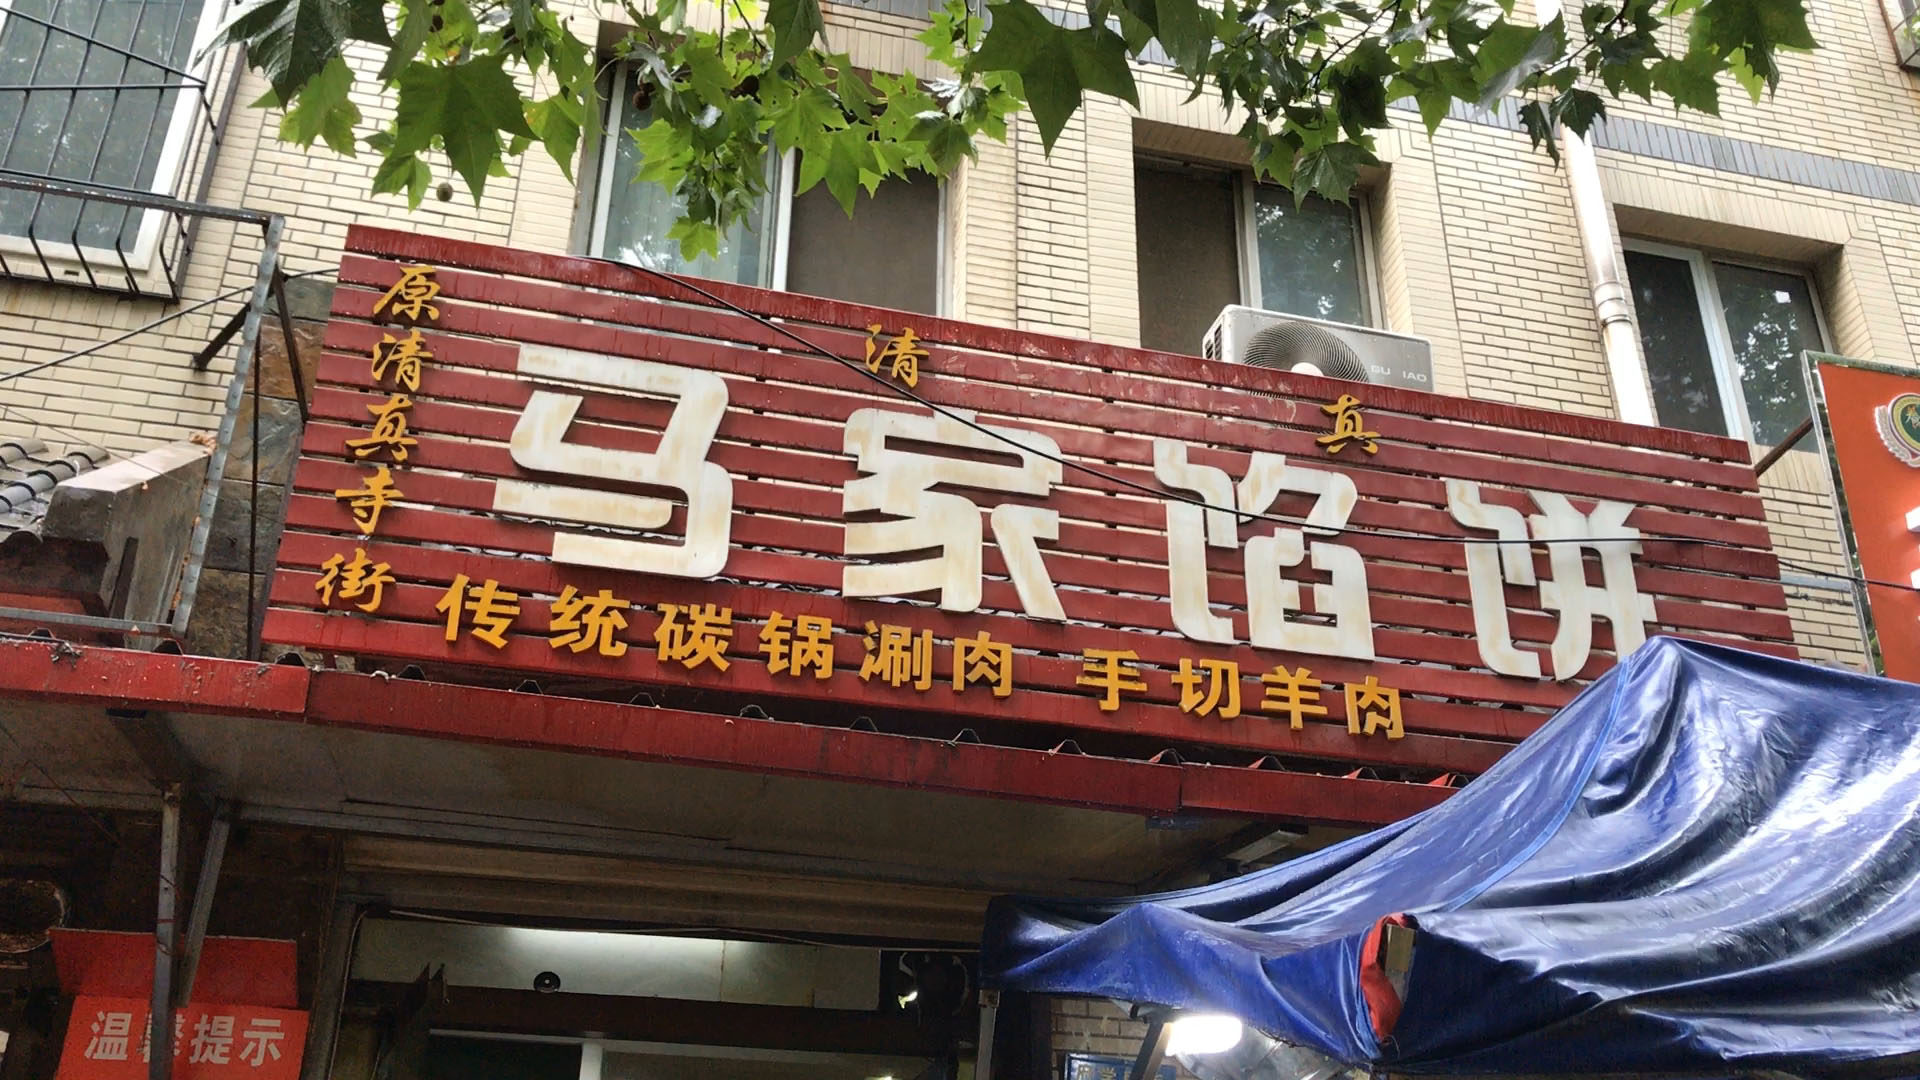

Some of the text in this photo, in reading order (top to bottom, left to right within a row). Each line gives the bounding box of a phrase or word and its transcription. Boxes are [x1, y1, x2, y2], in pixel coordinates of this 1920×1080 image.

[315, 264, 440, 612] 原清真寺街
[493, 343, 1657, 681] 马家馅饼
[863, 324, 1380, 455] 清 真
[436, 573, 1405, 740] 传统碳锅涮肉 手切羊肉
